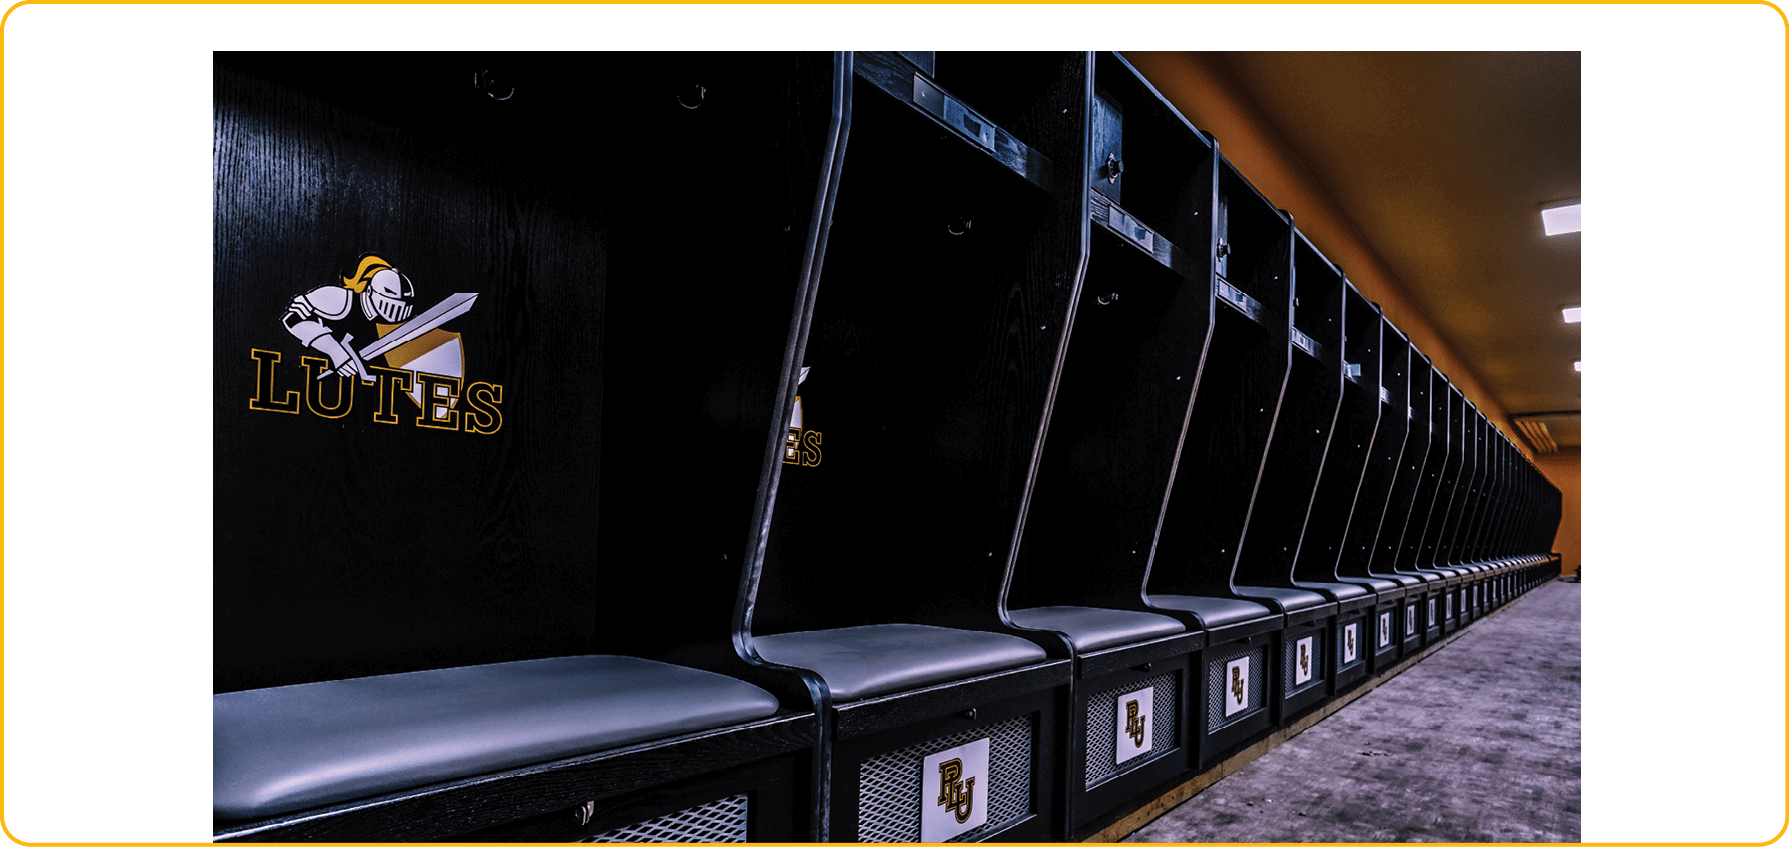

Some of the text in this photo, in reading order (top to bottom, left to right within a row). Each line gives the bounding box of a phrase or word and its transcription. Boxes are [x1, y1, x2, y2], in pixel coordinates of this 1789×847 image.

[249, 347, 503, 435] LUTES
[1231, 665, 1244, 705] PLU
[1125, 699, 1146, 748] PLU
[937, 757, 976, 824] PLU
